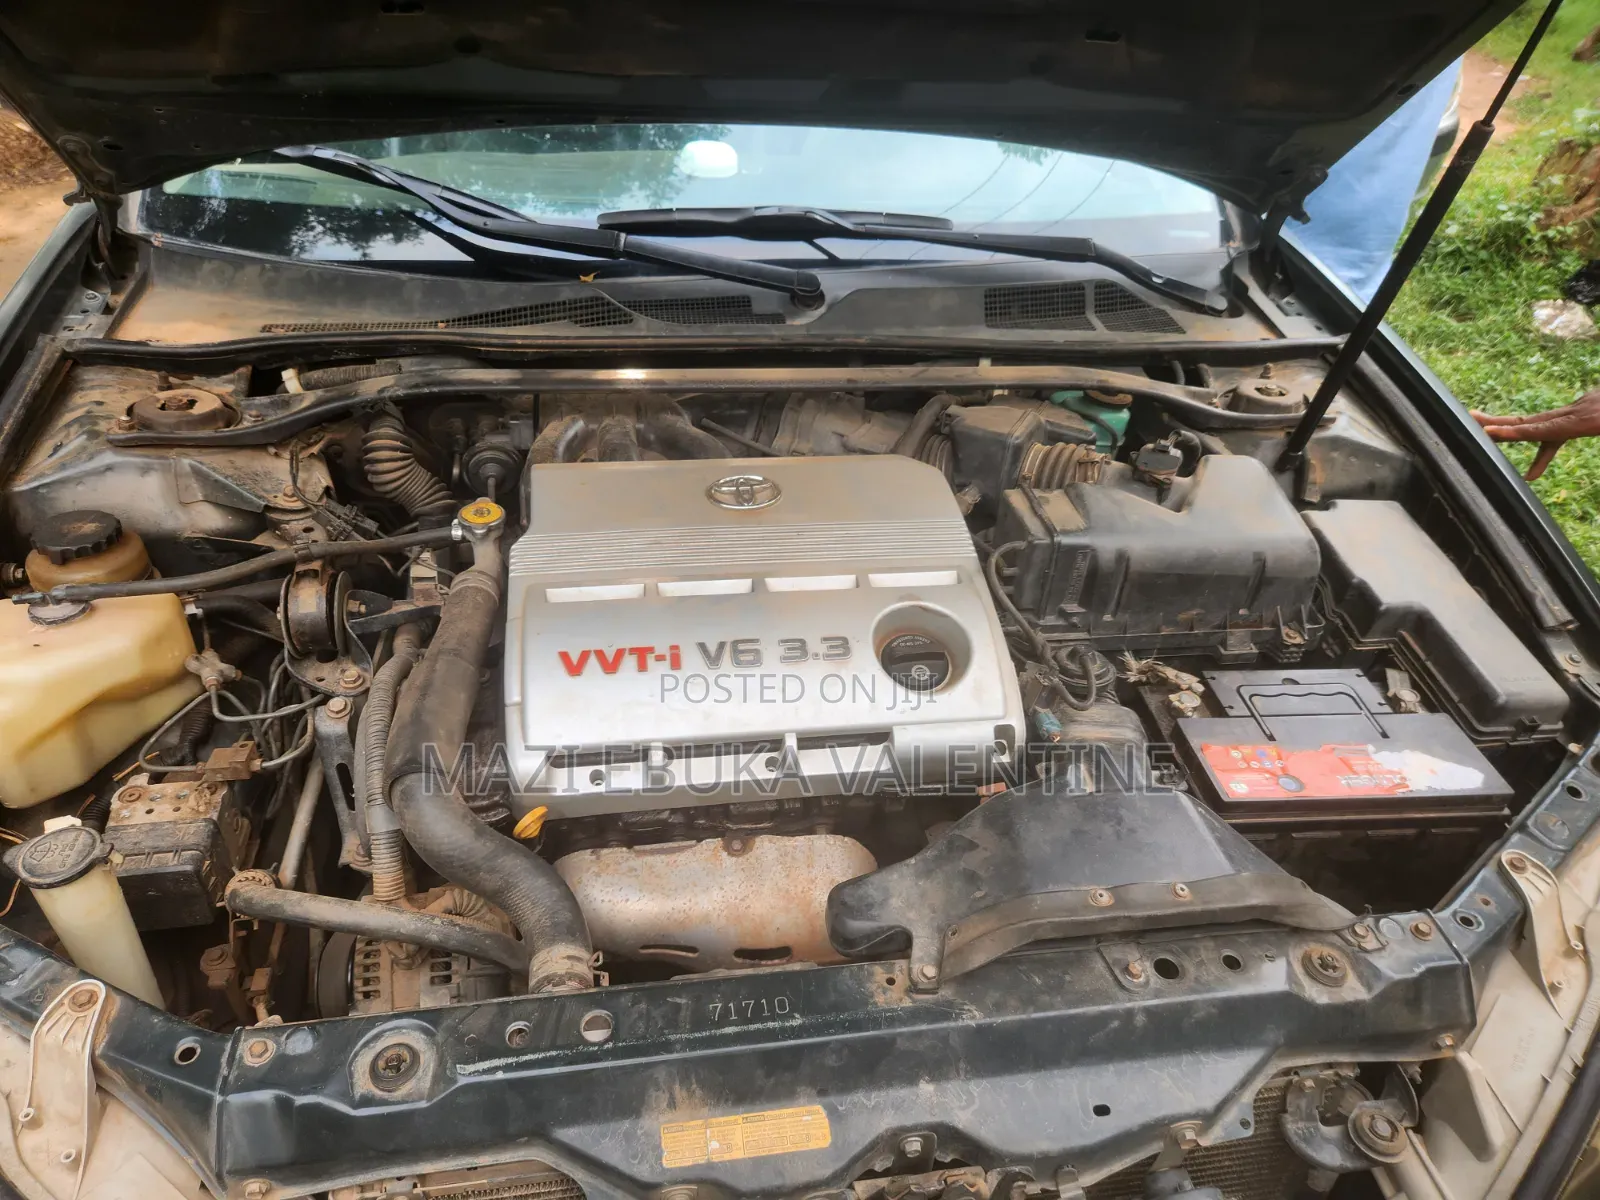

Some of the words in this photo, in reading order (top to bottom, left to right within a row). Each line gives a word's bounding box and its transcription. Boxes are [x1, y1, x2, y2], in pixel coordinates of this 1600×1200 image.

[557, 645, 683, 677] VVT-i
[696, 638, 763, 670] V6
[778, 636, 852, 664] 3.3
[709, 997, 789, 1021] 71710
